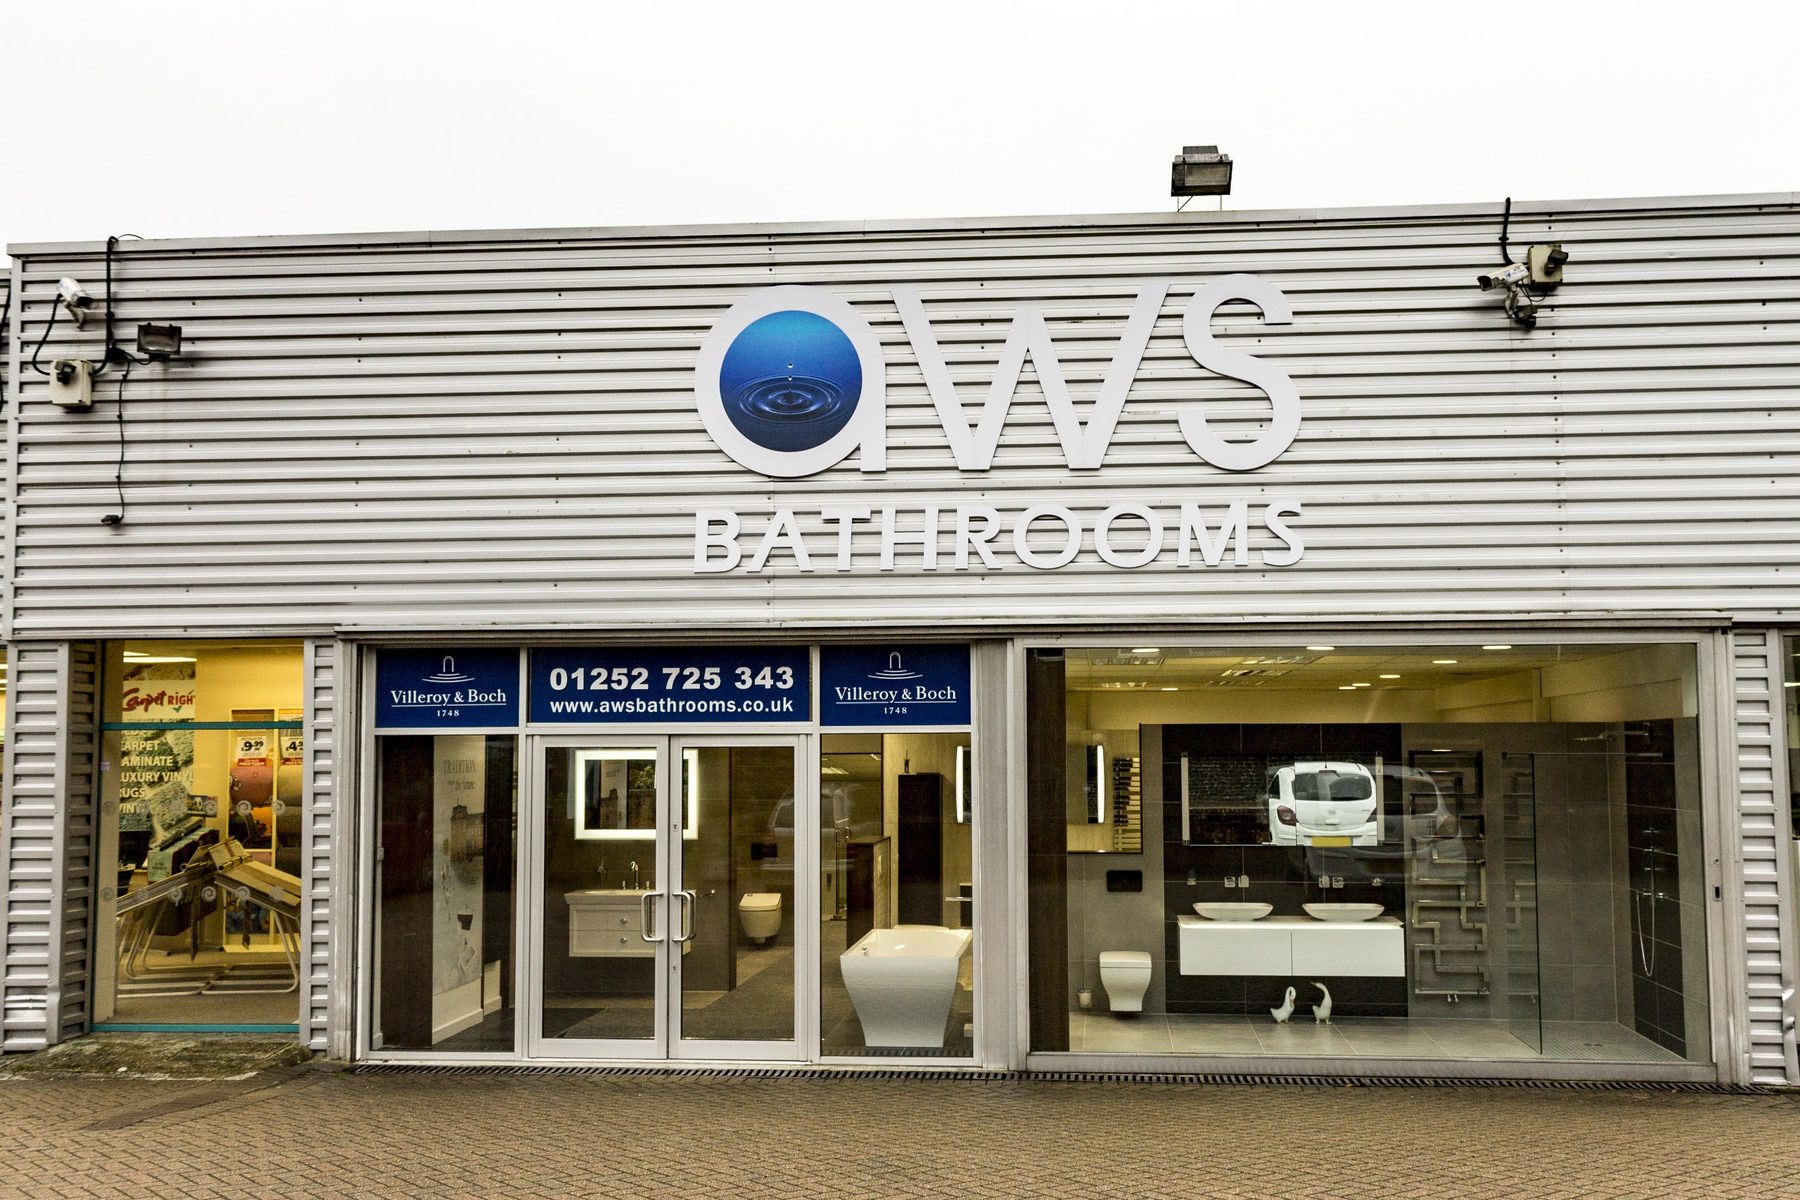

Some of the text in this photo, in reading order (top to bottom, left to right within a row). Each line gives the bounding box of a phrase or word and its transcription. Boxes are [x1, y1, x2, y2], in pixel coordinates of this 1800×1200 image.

[693, 500, 1305, 573] BATHROOMS
[550, 666, 794, 691] 01252 725 343
[390, 688, 507, 706] Villeroy & Boch
[835, 685, 957, 703] Villeroy & Boch
[436, 709, 460, 717] 1748
[550, 696, 794, 713] www.awsbathrooms.co.uk
[883, 706, 908, 714] 1748
[120, 756, 174, 767] AMINATE
[120, 771, 161, 782] UXURY
